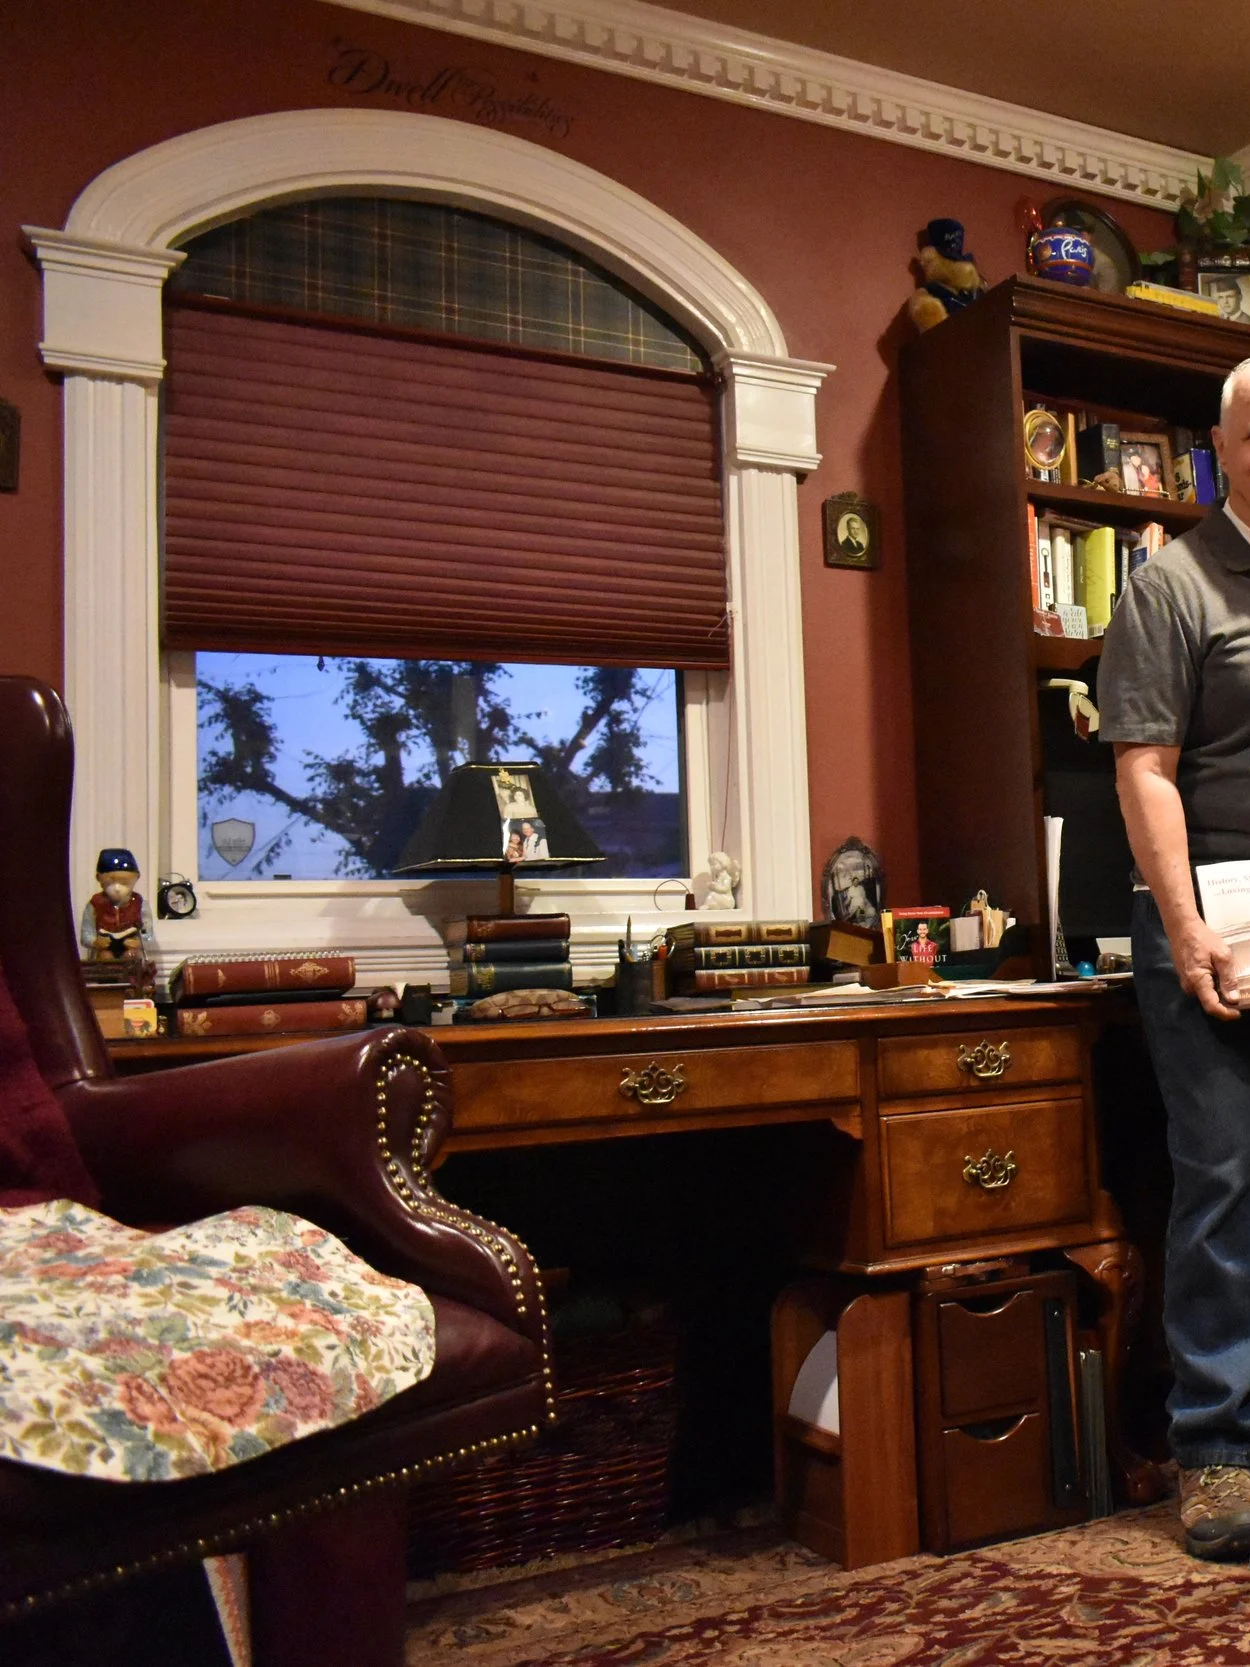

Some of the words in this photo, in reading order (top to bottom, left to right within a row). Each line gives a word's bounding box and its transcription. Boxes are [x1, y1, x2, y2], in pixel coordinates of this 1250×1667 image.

[327, 48, 452, 107] Dwell
[914, 944, 934, 953] LIFE
[900, 954, 948, 963] WITHOUT
